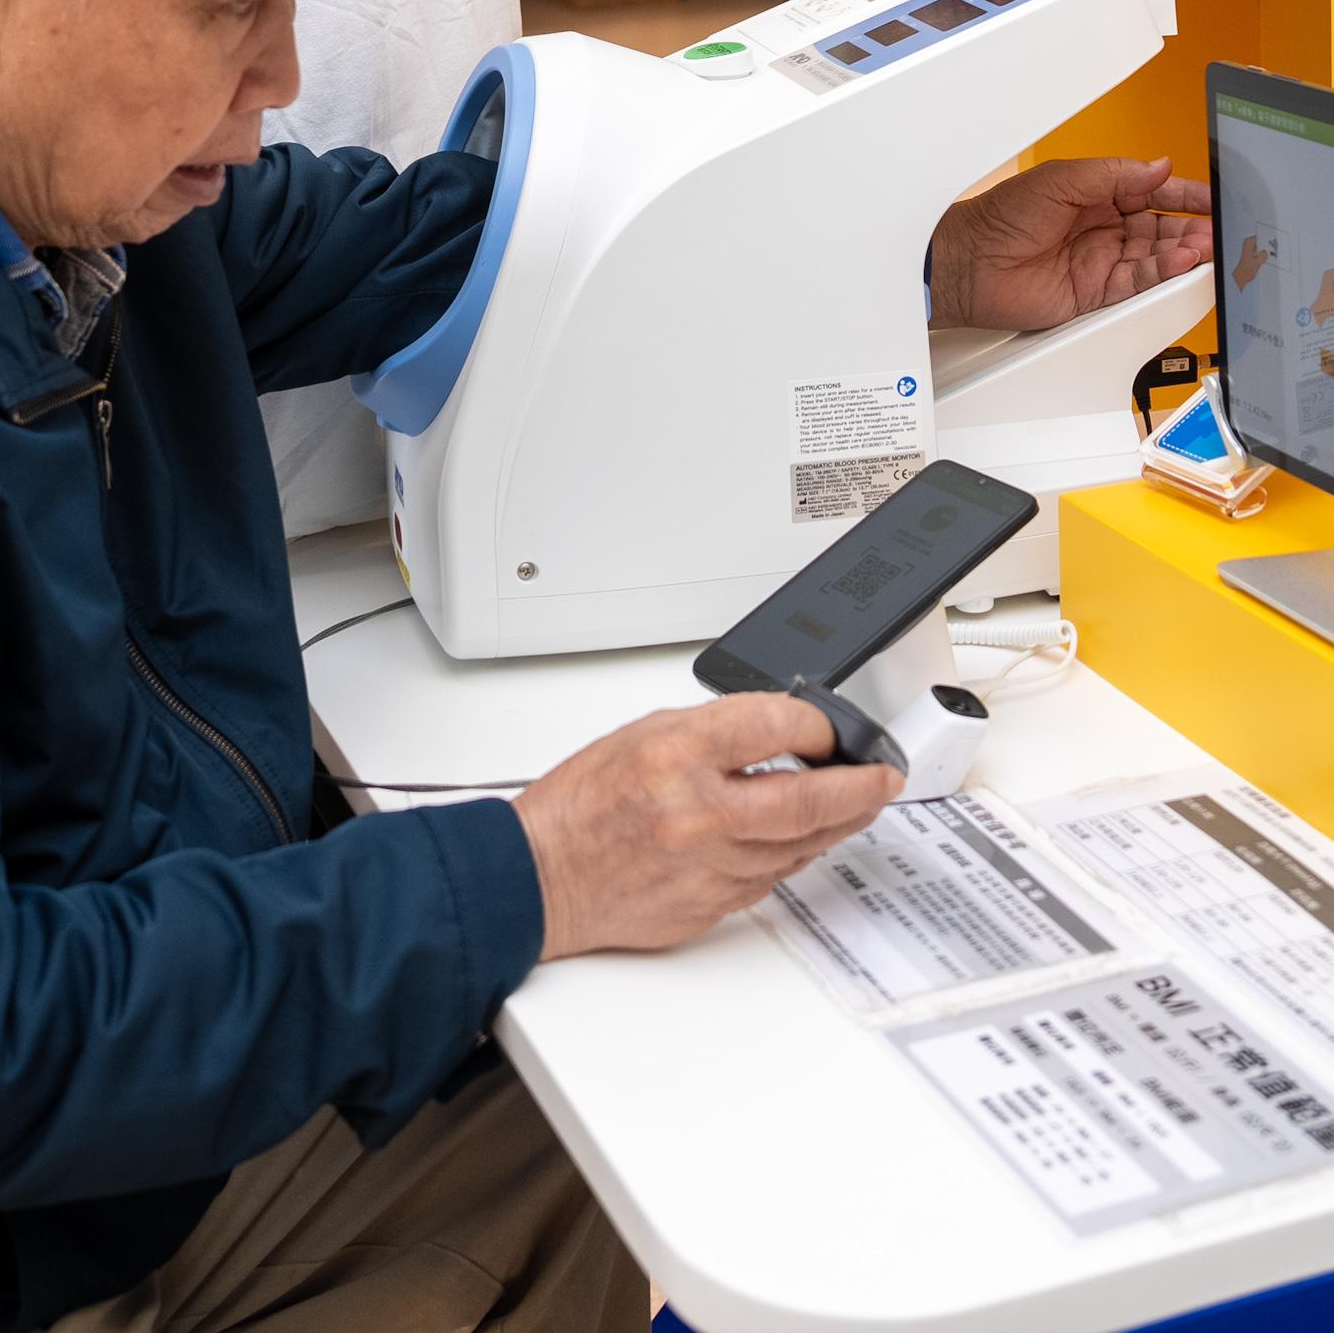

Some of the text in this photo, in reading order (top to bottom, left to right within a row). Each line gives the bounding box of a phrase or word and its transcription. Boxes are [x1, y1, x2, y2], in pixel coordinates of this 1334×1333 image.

[794, 382, 841, 393] INSTRUCTIONS
[795, 462, 833, 471] AUTOMATIC
[857, 456, 889, 464] PRESSURE
[892, 452, 920, 460] MONITOR
[1136, 974, 1202, 1018] BMI
